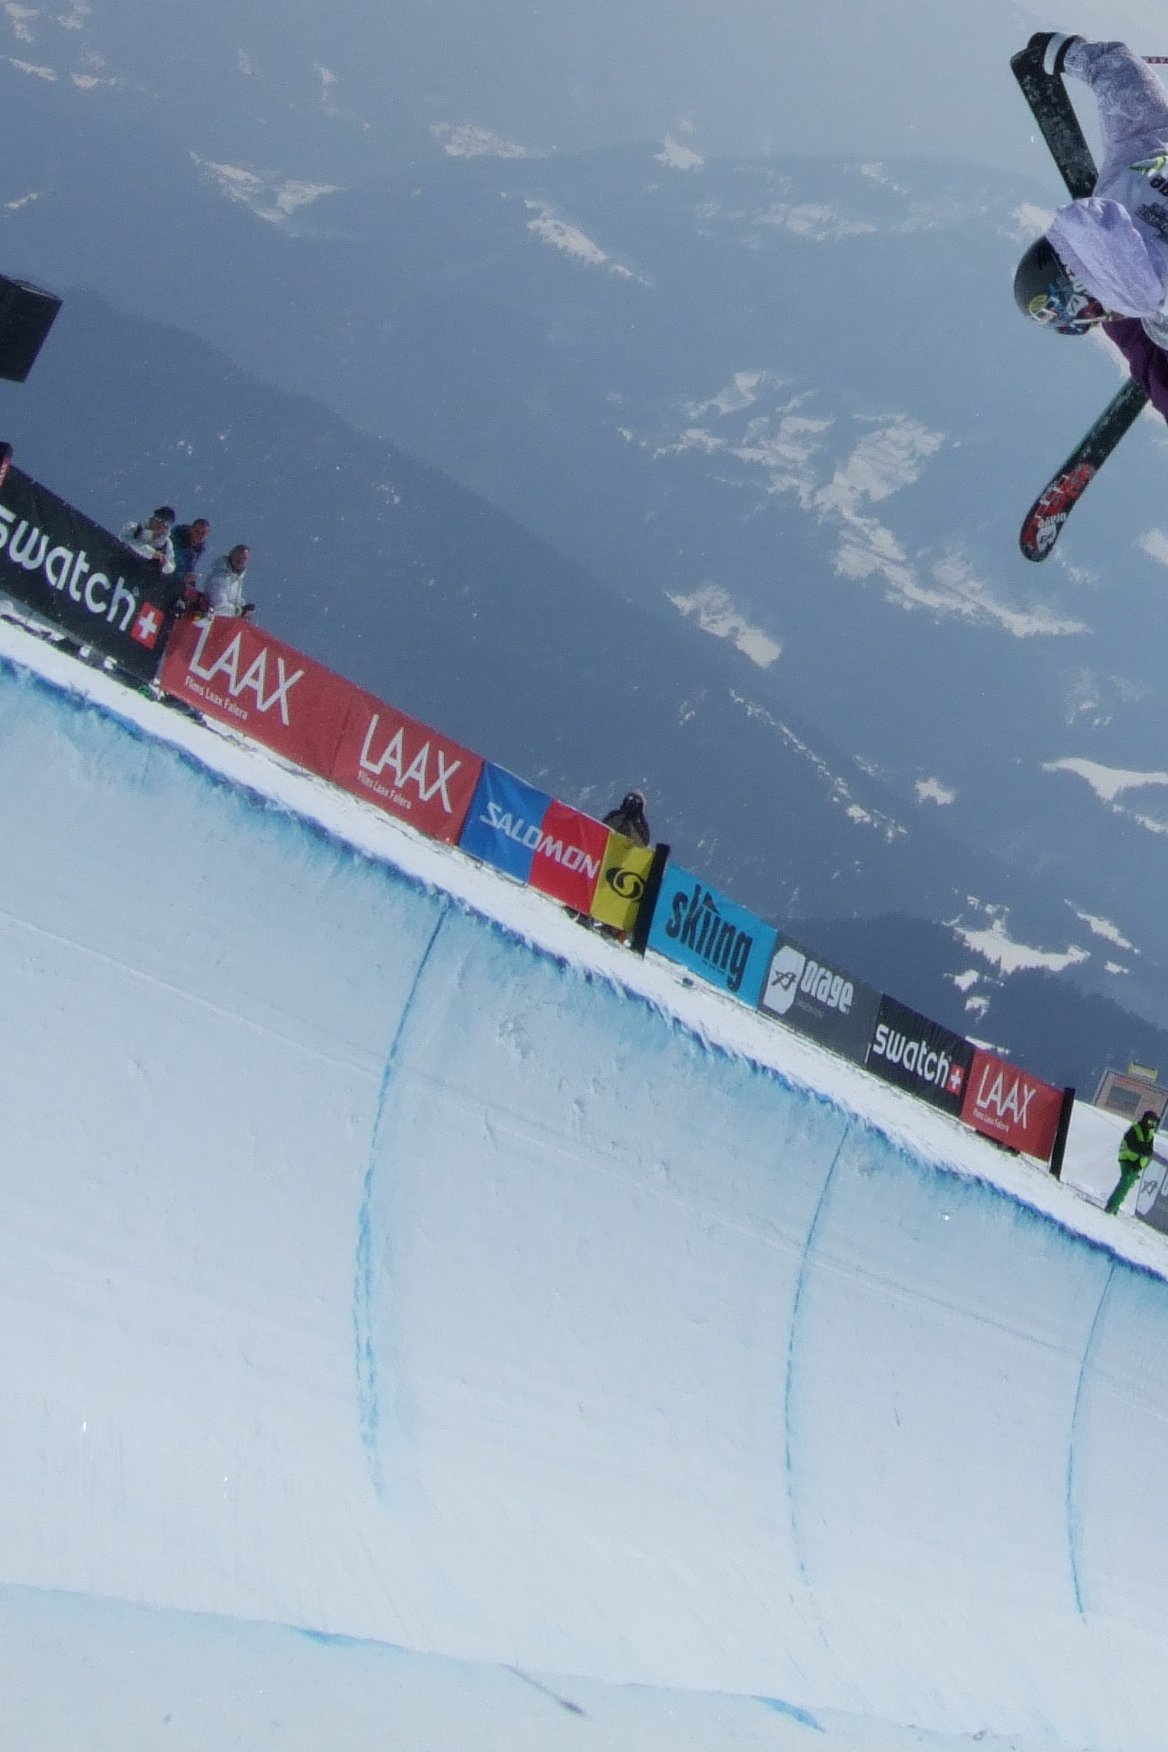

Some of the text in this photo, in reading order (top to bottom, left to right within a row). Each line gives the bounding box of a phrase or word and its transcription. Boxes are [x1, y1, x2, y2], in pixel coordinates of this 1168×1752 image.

[189, 616, 304, 726] LAAX
[360, 714, 462, 813] LAAX
[480, 801, 601, 879] SALOMON
[665, 884, 754, 992] skiing
[873, 1023, 950, 1088] swatch
[976, 1064, 1036, 1129] LAAX
